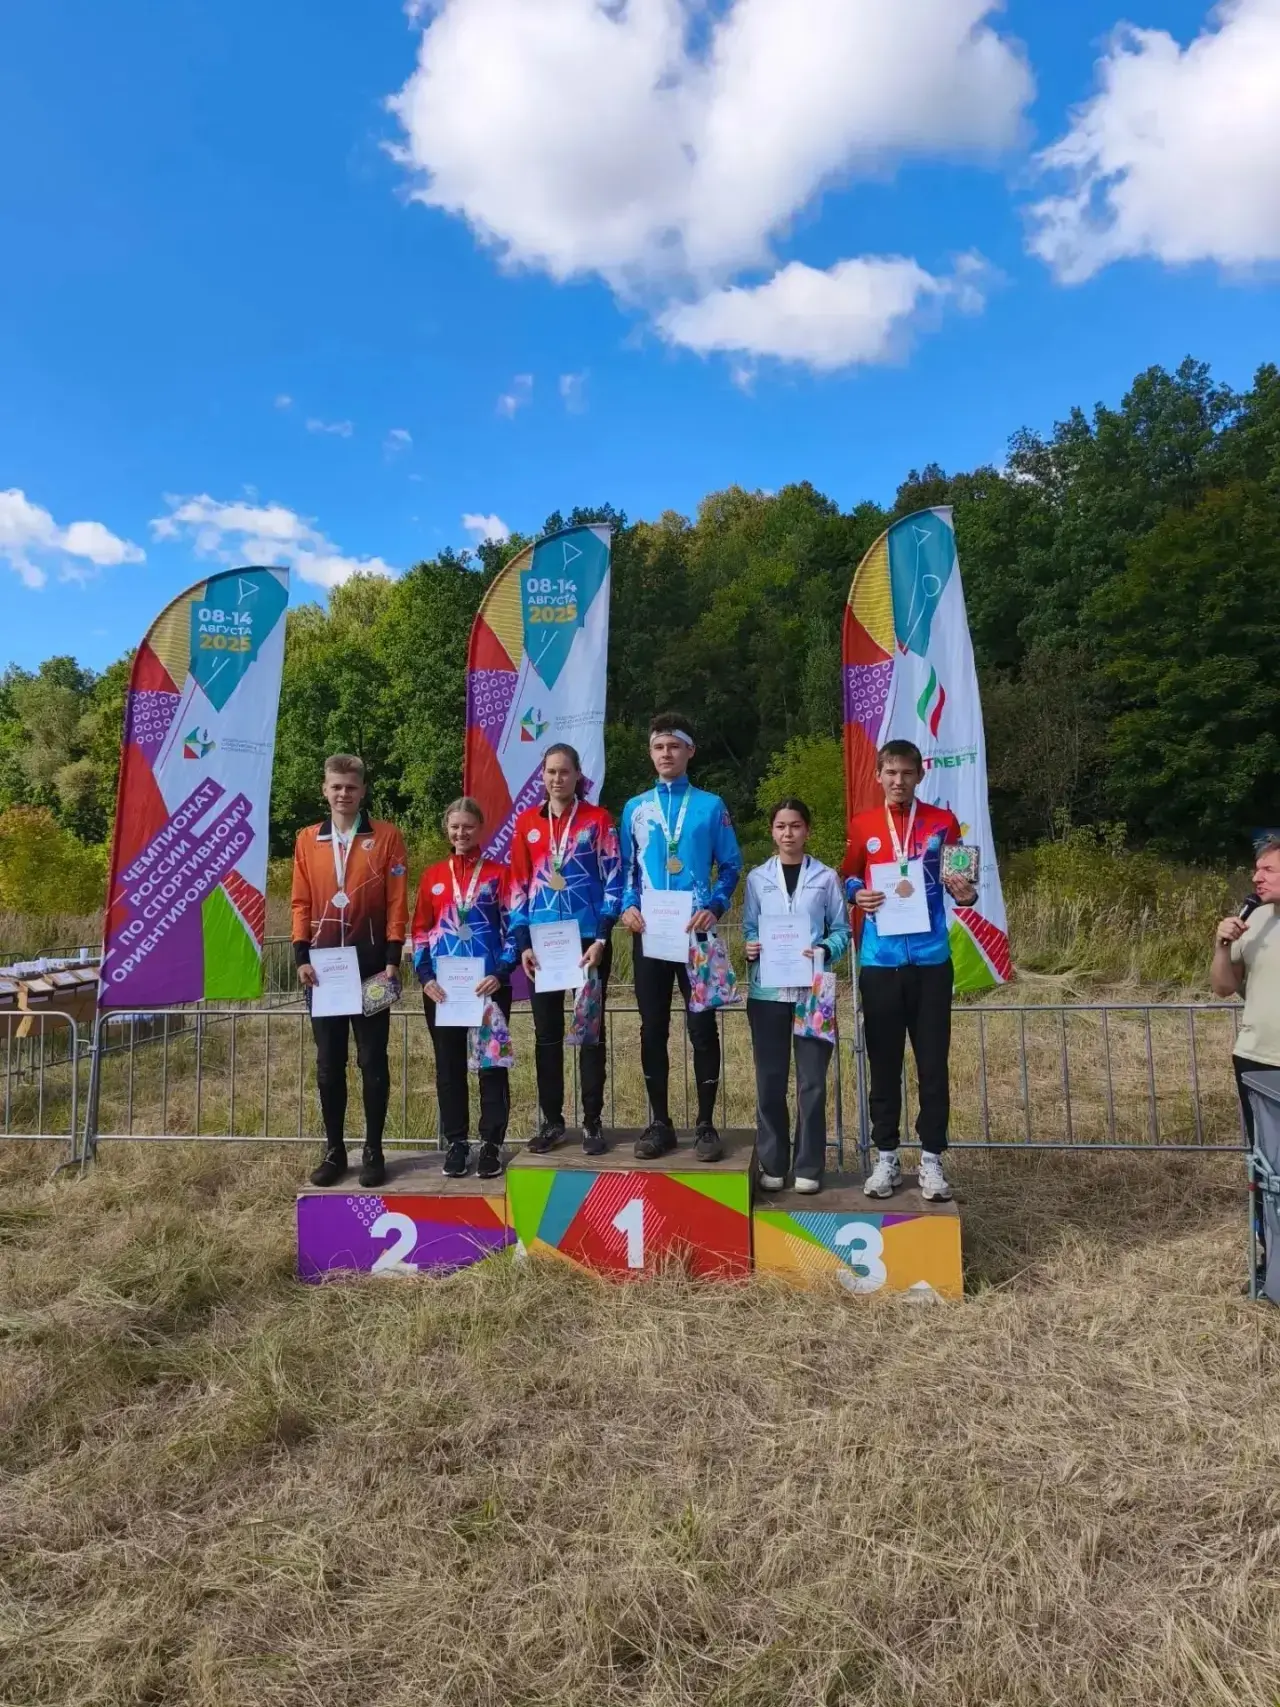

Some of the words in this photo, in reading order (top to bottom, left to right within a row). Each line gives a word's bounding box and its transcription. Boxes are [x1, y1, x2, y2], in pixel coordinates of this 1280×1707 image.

[198, 607, 253, 625] 08-14
[526, 578, 577, 594] 08-14
[528, 594, 577, 605] АВГУСТА
[528, 604, 577, 624] 2025
[198, 623, 252, 636] АВГУСТА
[200, 633, 252, 652] 2025
[122, 784, 214, 882] ЧЕМПИОНАТ
[119, 919, 144, 946] ПО
[143, 801, 246, 919] СПОРТИВНОМУ
[129, 839, 191, 907] РОССИИ
[111, 831, 247, 983] ОРИЕНТИРОВАНИЮ
[371, 1212, 418, 1275] 2
[612, 1198, 644, 1269] 1
[835, 1222, 887, 1294] 3
